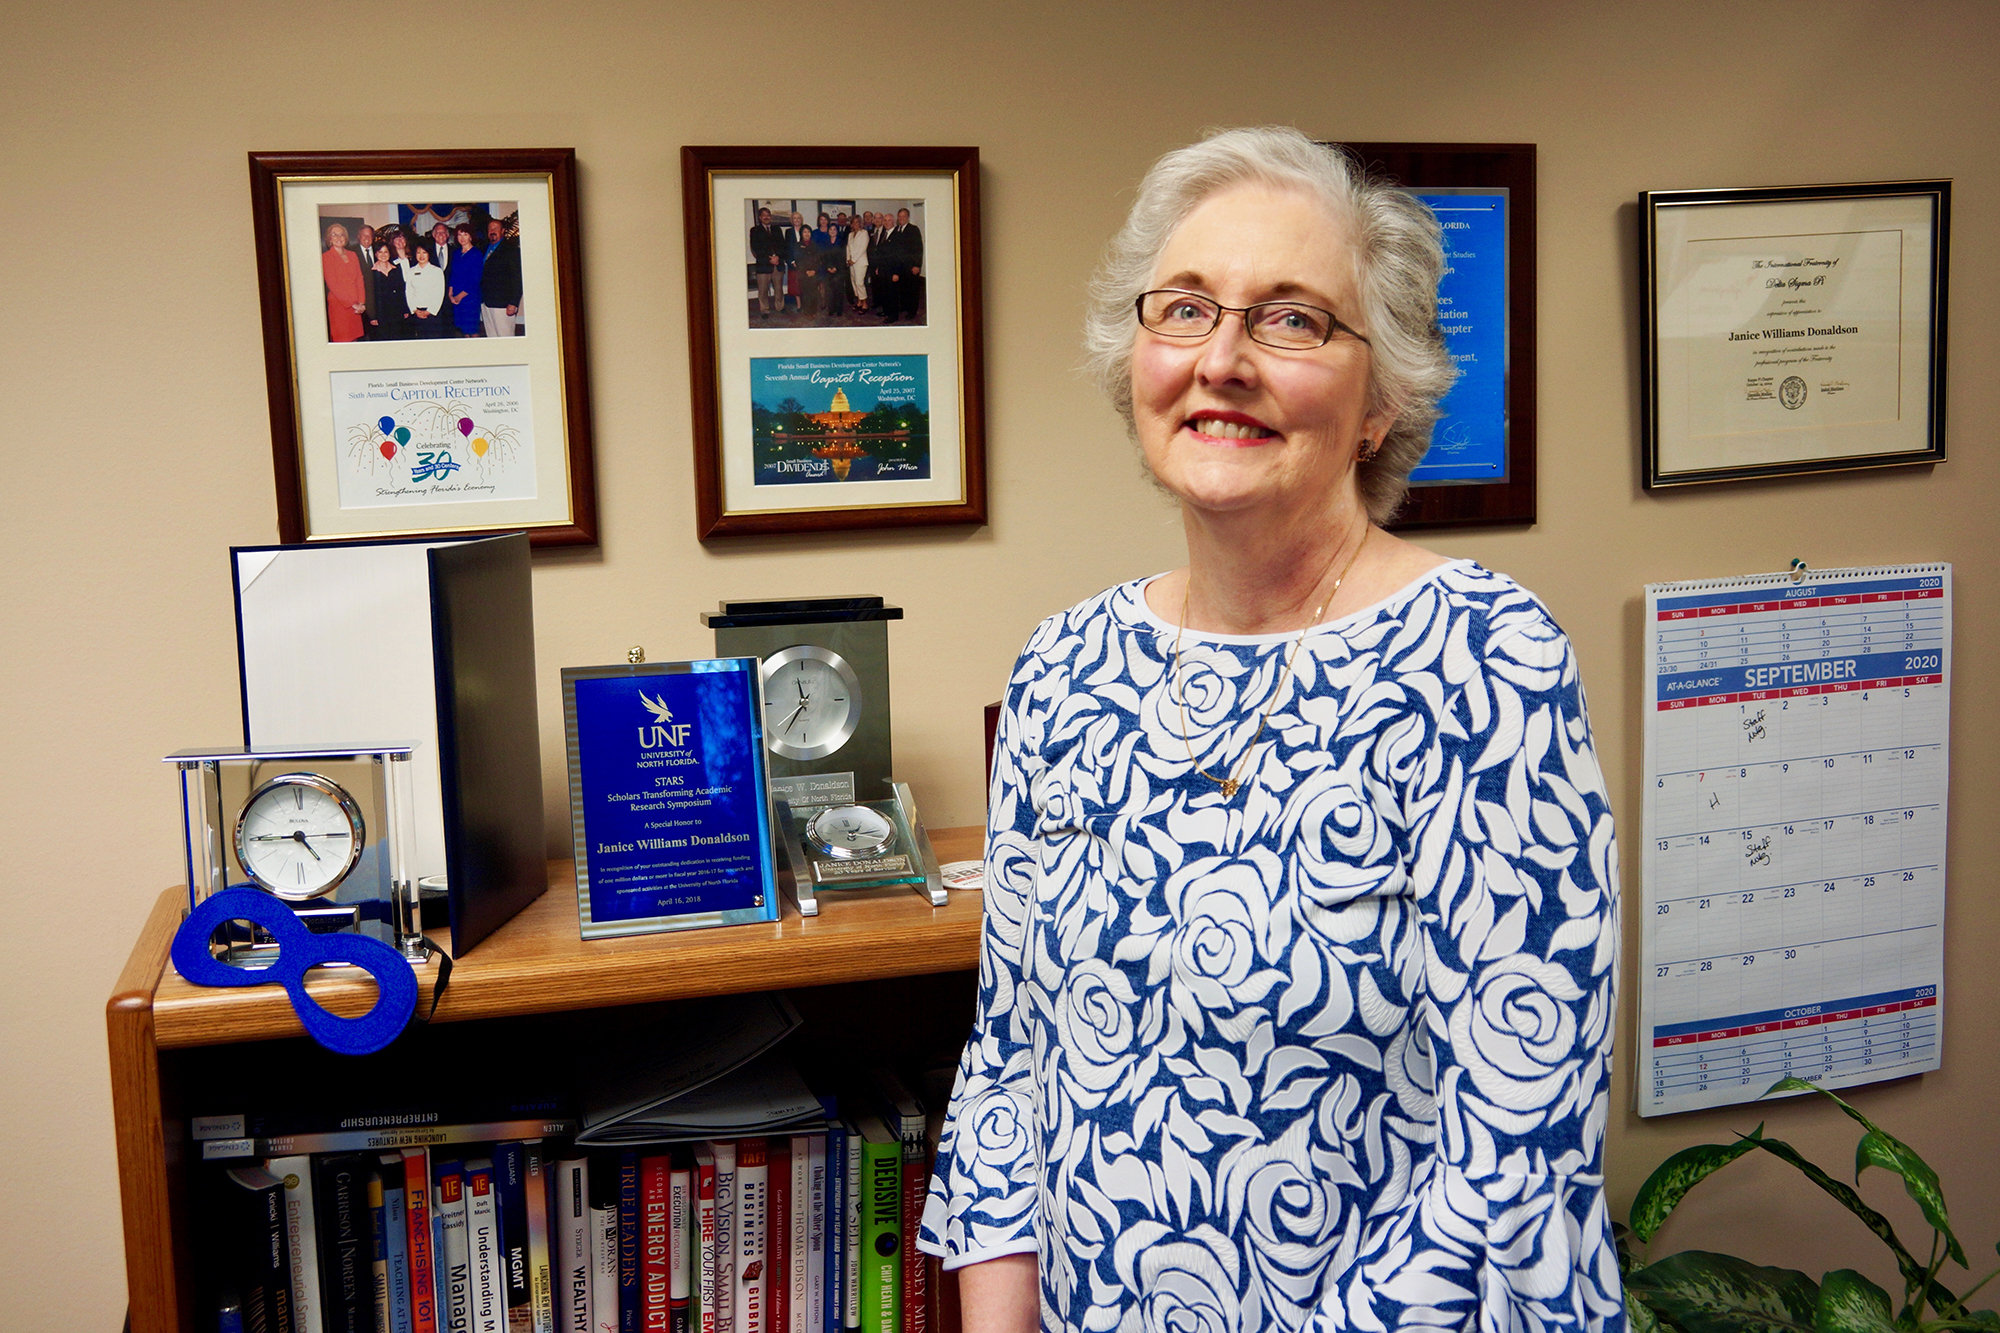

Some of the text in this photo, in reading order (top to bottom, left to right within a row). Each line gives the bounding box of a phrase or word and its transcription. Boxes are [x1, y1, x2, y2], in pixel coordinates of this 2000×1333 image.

[1452, 251, 1476, 259] Studies
[1788, 276, 1812, 291] Sigma
[1728, 325, 1858, 342] Janice Williams Donaldson
[810, 370, 855, 388] Capitol
[858, 368, 914, 386] Reception
[348, 385, 511, 400] Sixth Annual CAPITOL RECEPTION
[416, 442, 452, 450] Celebrating
[412, 450, 452, 482] 30
[877, 462, 895, 474] John
[376, 483, 496, 498] Strengthening Florida's Economy
[1786, 588, 1817, 598] AUGUST
[1919, 578, 1940, 588] 2020
[1744, 659, 1857, 688] SEPTEMBER
[1905, 655, 1938, 670] 2020
[1670, 676, 1929, 709] SUN MON TUE WED THU FRI SAT
[1740, 688, 1910, 714] 1 2 3 4 5
[1743, 710, 1766, 730] Staff
[638, 724, 691, 749] UNF
[636, 760, 664, 768] NORTH
[641, 750, 684, 760] UNIVERSITY
[654, 776, 684, 786] STARS
[1658, 750, 1914, 788] 6 7 8 9 10 11 12
[608, 784, 732, 802] Scholars Transforming Academic
[796, 780, 850, 792] W. Donaldson
[830, 793, 852, 801] Florida
[630, 798, 712, 812] Research Symposium
[650, 819, 673, 830] Special
[674, 818, 693, 827] Honor
[1658, 810, 1914, 851] 13 14 15 16 17 18 19
[596, 832, 750, 854] Janice Williams Donaldson
[1745, 836, 1772, 857] Staff
[853, 857, 906, 866] DONALDSON
[658, 898, 672, 907] April
[1657, 872, 1914, 914] 20 21 22 23 24 25 26
[1657, 950, 1796, 977] 27 28 29 30
[1915, 988, 1934, 998] 2020
[1784, 1005, 1822, 1018] OCTOBER
[340, 1112, 438, 1128] ENTREPRENEURSHIP
[544, 1124, 564, 1132] ALLEN
[368, 1138, 398, 1147] VENTURES
[399, 1136, 413, 1145] NEW
[414, 1133, 446, 1144] LAUNCHING
[508, 1152, 516, 1186] WILLIAMS
[530, 1156, 538, 1177] ALLEN
[718, 1172, 734, 1200] BIG
[874, 1157, 897, 1226] DECISIVE
[914, 1174, 926, 1210] THE
[336, 1172, 352, 1238] GARRISON
[673, 1186, 682, 1230] EXECUTION
[811, 1166, 824, 1252] Choking on the Silver Spoon
[268, 1192, 280, 1268] Kinicki Williams
[622, 1162, 636, 1287] TRUE LEADERS
[716, 1202, 734, 1258] VISION,
[744, 1183, 755, 1256] BUSINESS
[288, 1200, 308, 1302] Entrepreneurial
[603, 1202, 617, 1278] JIM MORAN:
[412, 1190, 430, 1322] FRANCHISING 101
[510, 1247, 524, 1290] MGMT
[648, 1202, 666, 1330] ENERGY ADDICT
[702, 1207, 714, 1308] HIRE YOUR FIRST
[795, 1212, 804, 1301] THOMAS EDISON
[341, 1247, 356, 1300] NOREEN
[478, 1226, 494, 1316] Understanding
[881, 1264, 892, 1283] CHIP
[540, 1265, 550, 1308] LAUNCHING NEW
[574, 1266, 587, 1332] WEALTHY
[718, 1263, 733, 1313] SMALL
[881, 1284, 892, 1310] HEATH
